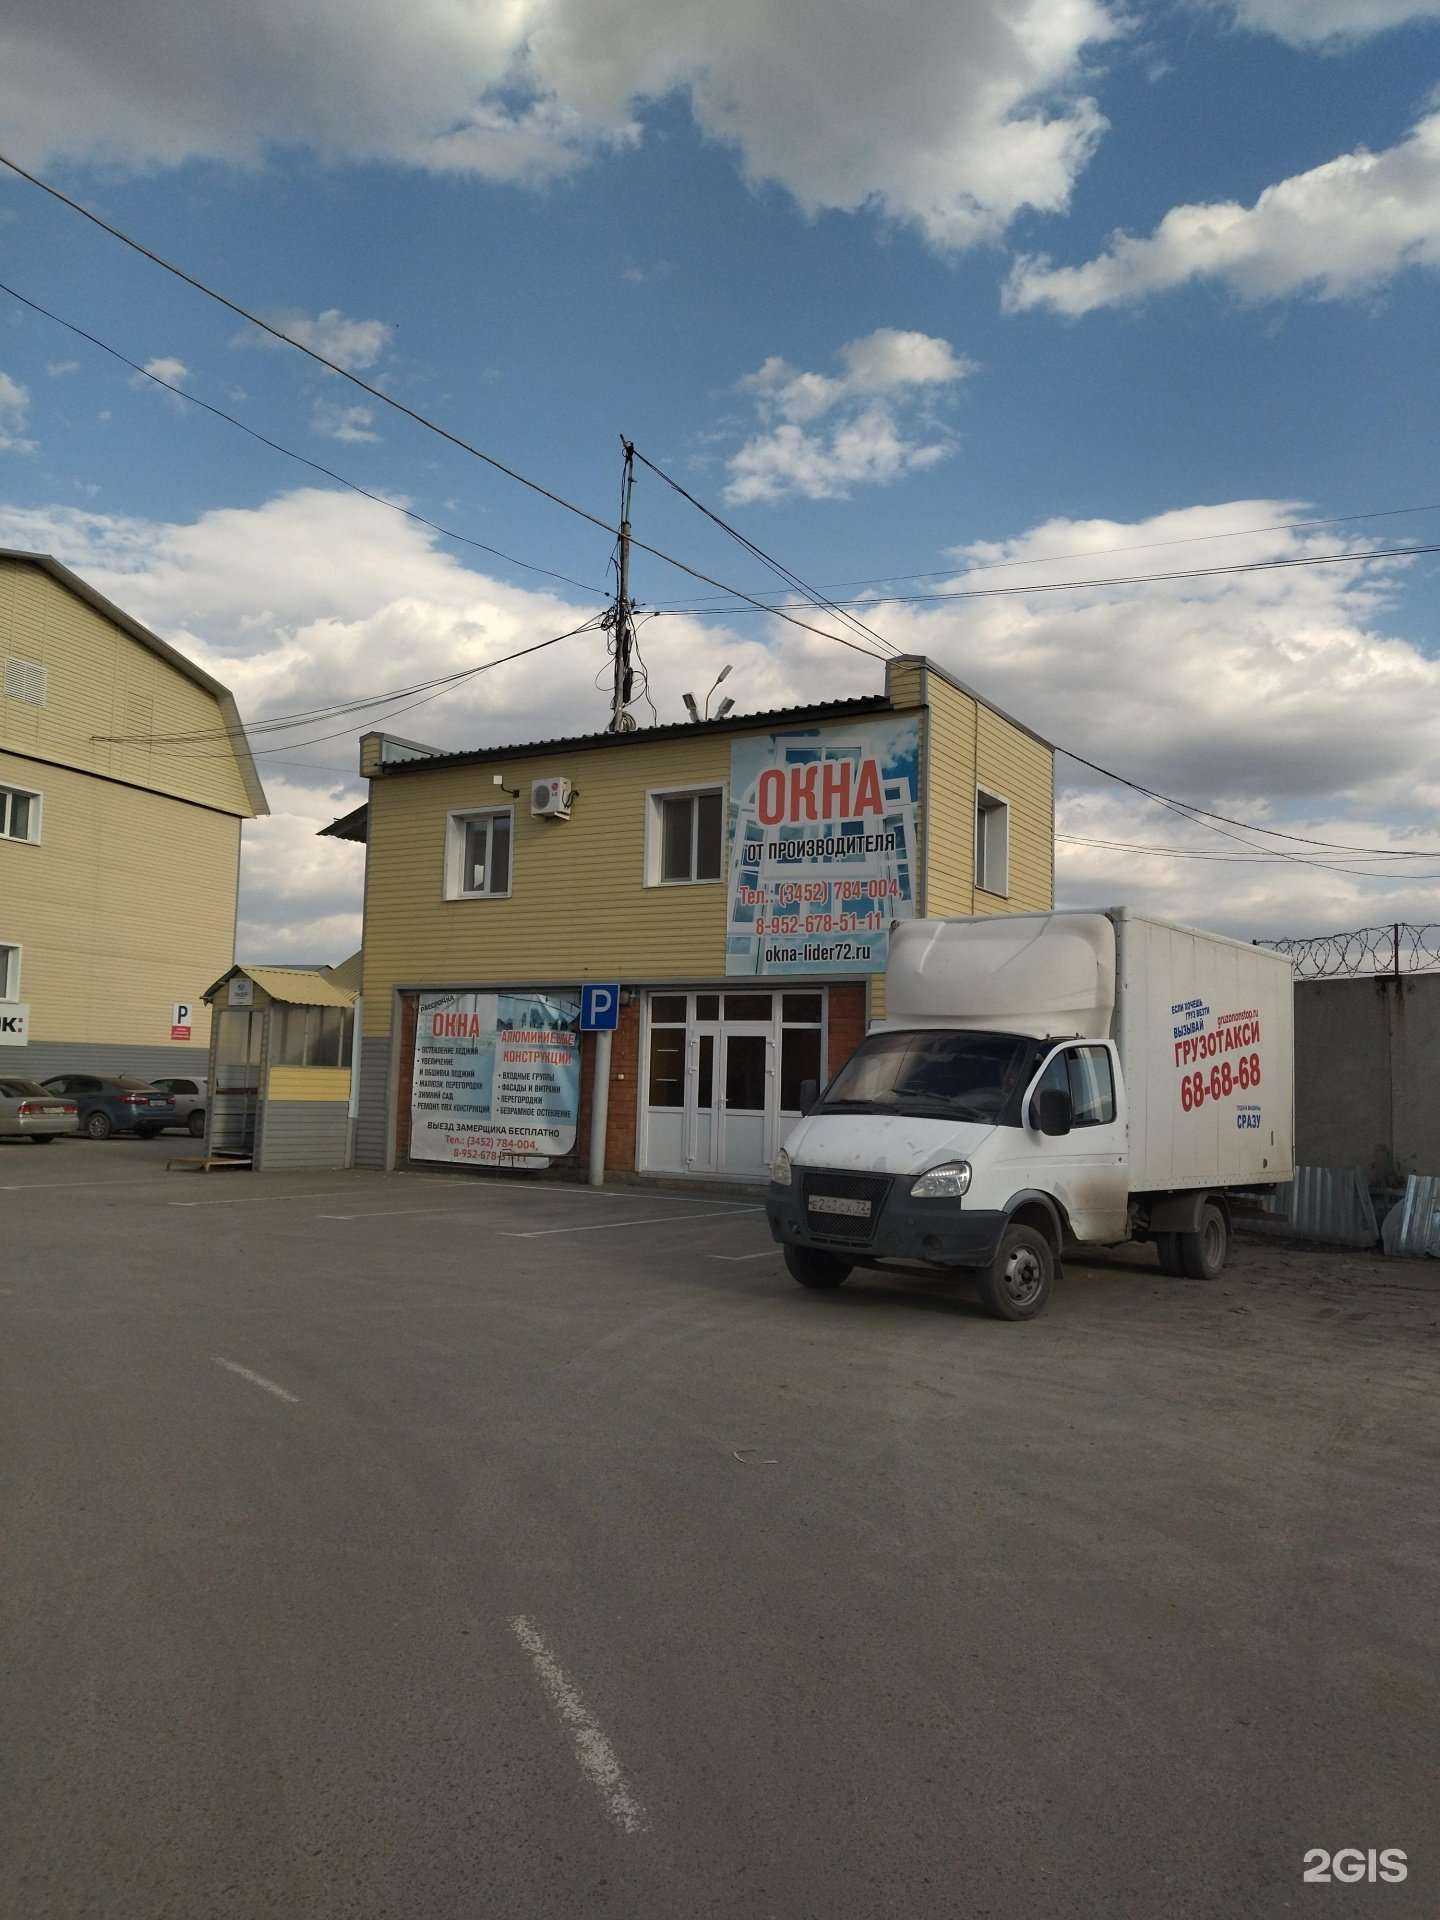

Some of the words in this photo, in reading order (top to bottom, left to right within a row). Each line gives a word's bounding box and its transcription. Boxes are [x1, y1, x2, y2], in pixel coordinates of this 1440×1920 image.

[758, 759, 884, 825] ОКНА
[747, 844, 764, 861] ОТ
[768, 833, 895, 860] ПРОИЗВОДИТЕЛЯ
[779, 881, 828, 906] (3452)
[755, 912, 882, 936] 8-952-678-51-11
[765, 943, 871, 962] okna-lider72.ru
[591, 989, 612, 1025] P
[1171, 1002, 1184, 1014] ЕСЛИ
[1185, 1011, 1196, 1021] ГРУЗ
[1196, 1007, 1210, 1017] ВЕЗТИ
[0, 1017, 23, 1033] К:
[432, 1012, 480, 1037] ОКНА
[1173, 1018, 1205, 1039] ВЫЗЫВАЙ
[1174, 1020, 1260, 1067] ГРУЗОТАКСИ
[503, 1050, 572, 1066] КОНСТРУКЦИИ
[502, 1072, 530, 1081] ВХОДНЫЕ
[532, 1072, 555, 1081] ГРУППЫ
[1181, 1053, 1261, 1113] 68-68-68
[501, 1084, 527, 1092] ФАСАДЫ
[442, 1092, 454, 1101] САД
[501, 1095, 543, 1104] ПЕРЕГОРОДКИ
[417, 1102, 440, 1111] РЕМОНТ
[440, 1103, 453, 1111] ПВХ
[500, 1107, 535, 1116] БЕЗРАМНОЕ
[427, 1121, 454, 1132] ВЫЕЗД
[456, 1123, 507, 1135] ЗАМЕРЩИКА
[508, 1127, 560, 1138] БЕСПЛАТНО
[1237, 1114, 1261, 1129] СРАЗУ
[445, 1135, 464, 1145] Тел.:
[467, 1136, 494, 1149] (3452)
[496, 1138, 539, 1151] 784-004,
